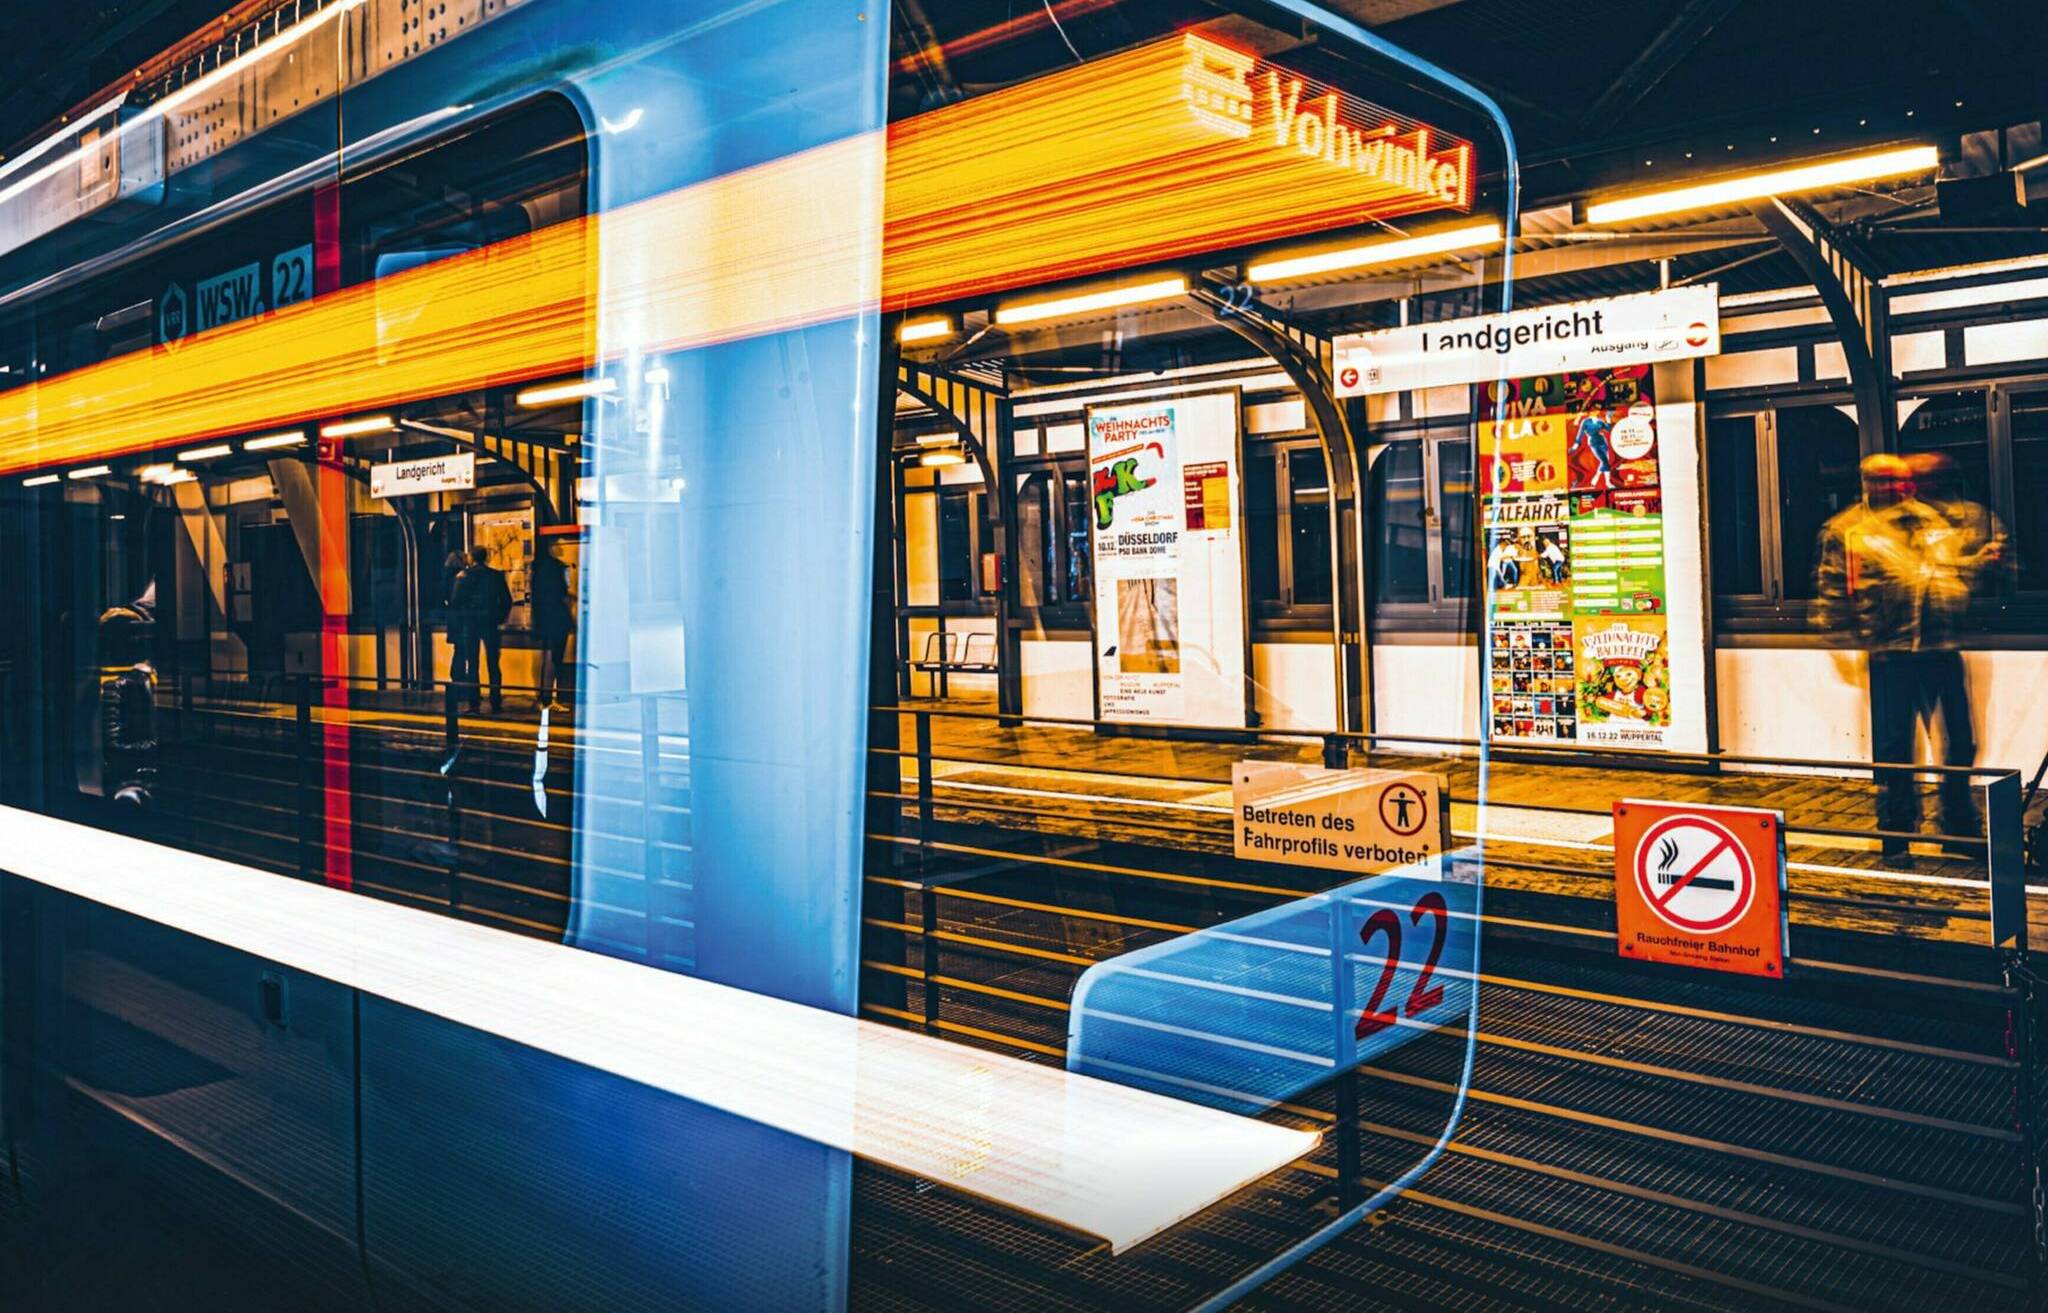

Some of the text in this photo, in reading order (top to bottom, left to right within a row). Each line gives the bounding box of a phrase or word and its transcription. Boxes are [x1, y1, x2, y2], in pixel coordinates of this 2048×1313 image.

[1269, 69, 1471, 207] Vohwinkel
[277, 256, 306, 306] 22
[1095, 415, 1171, 433] WEIHNACHTS
[1104, 430, 1138, 443] PARTY
[1508, 419, 1535, 441] LA
[396, 462, 446, 482] Landgericht
[1118, 531, 1179, 546] DÜSSELDORF
[1242, 805, 1355, 832] Betreten des
[1243, 827, 1429, 866] Fahrprofils verboten
[1636, 932, 1761, 957] Rauchfreier Bahnhof
[1355, 892, 1448, 1041] 22
